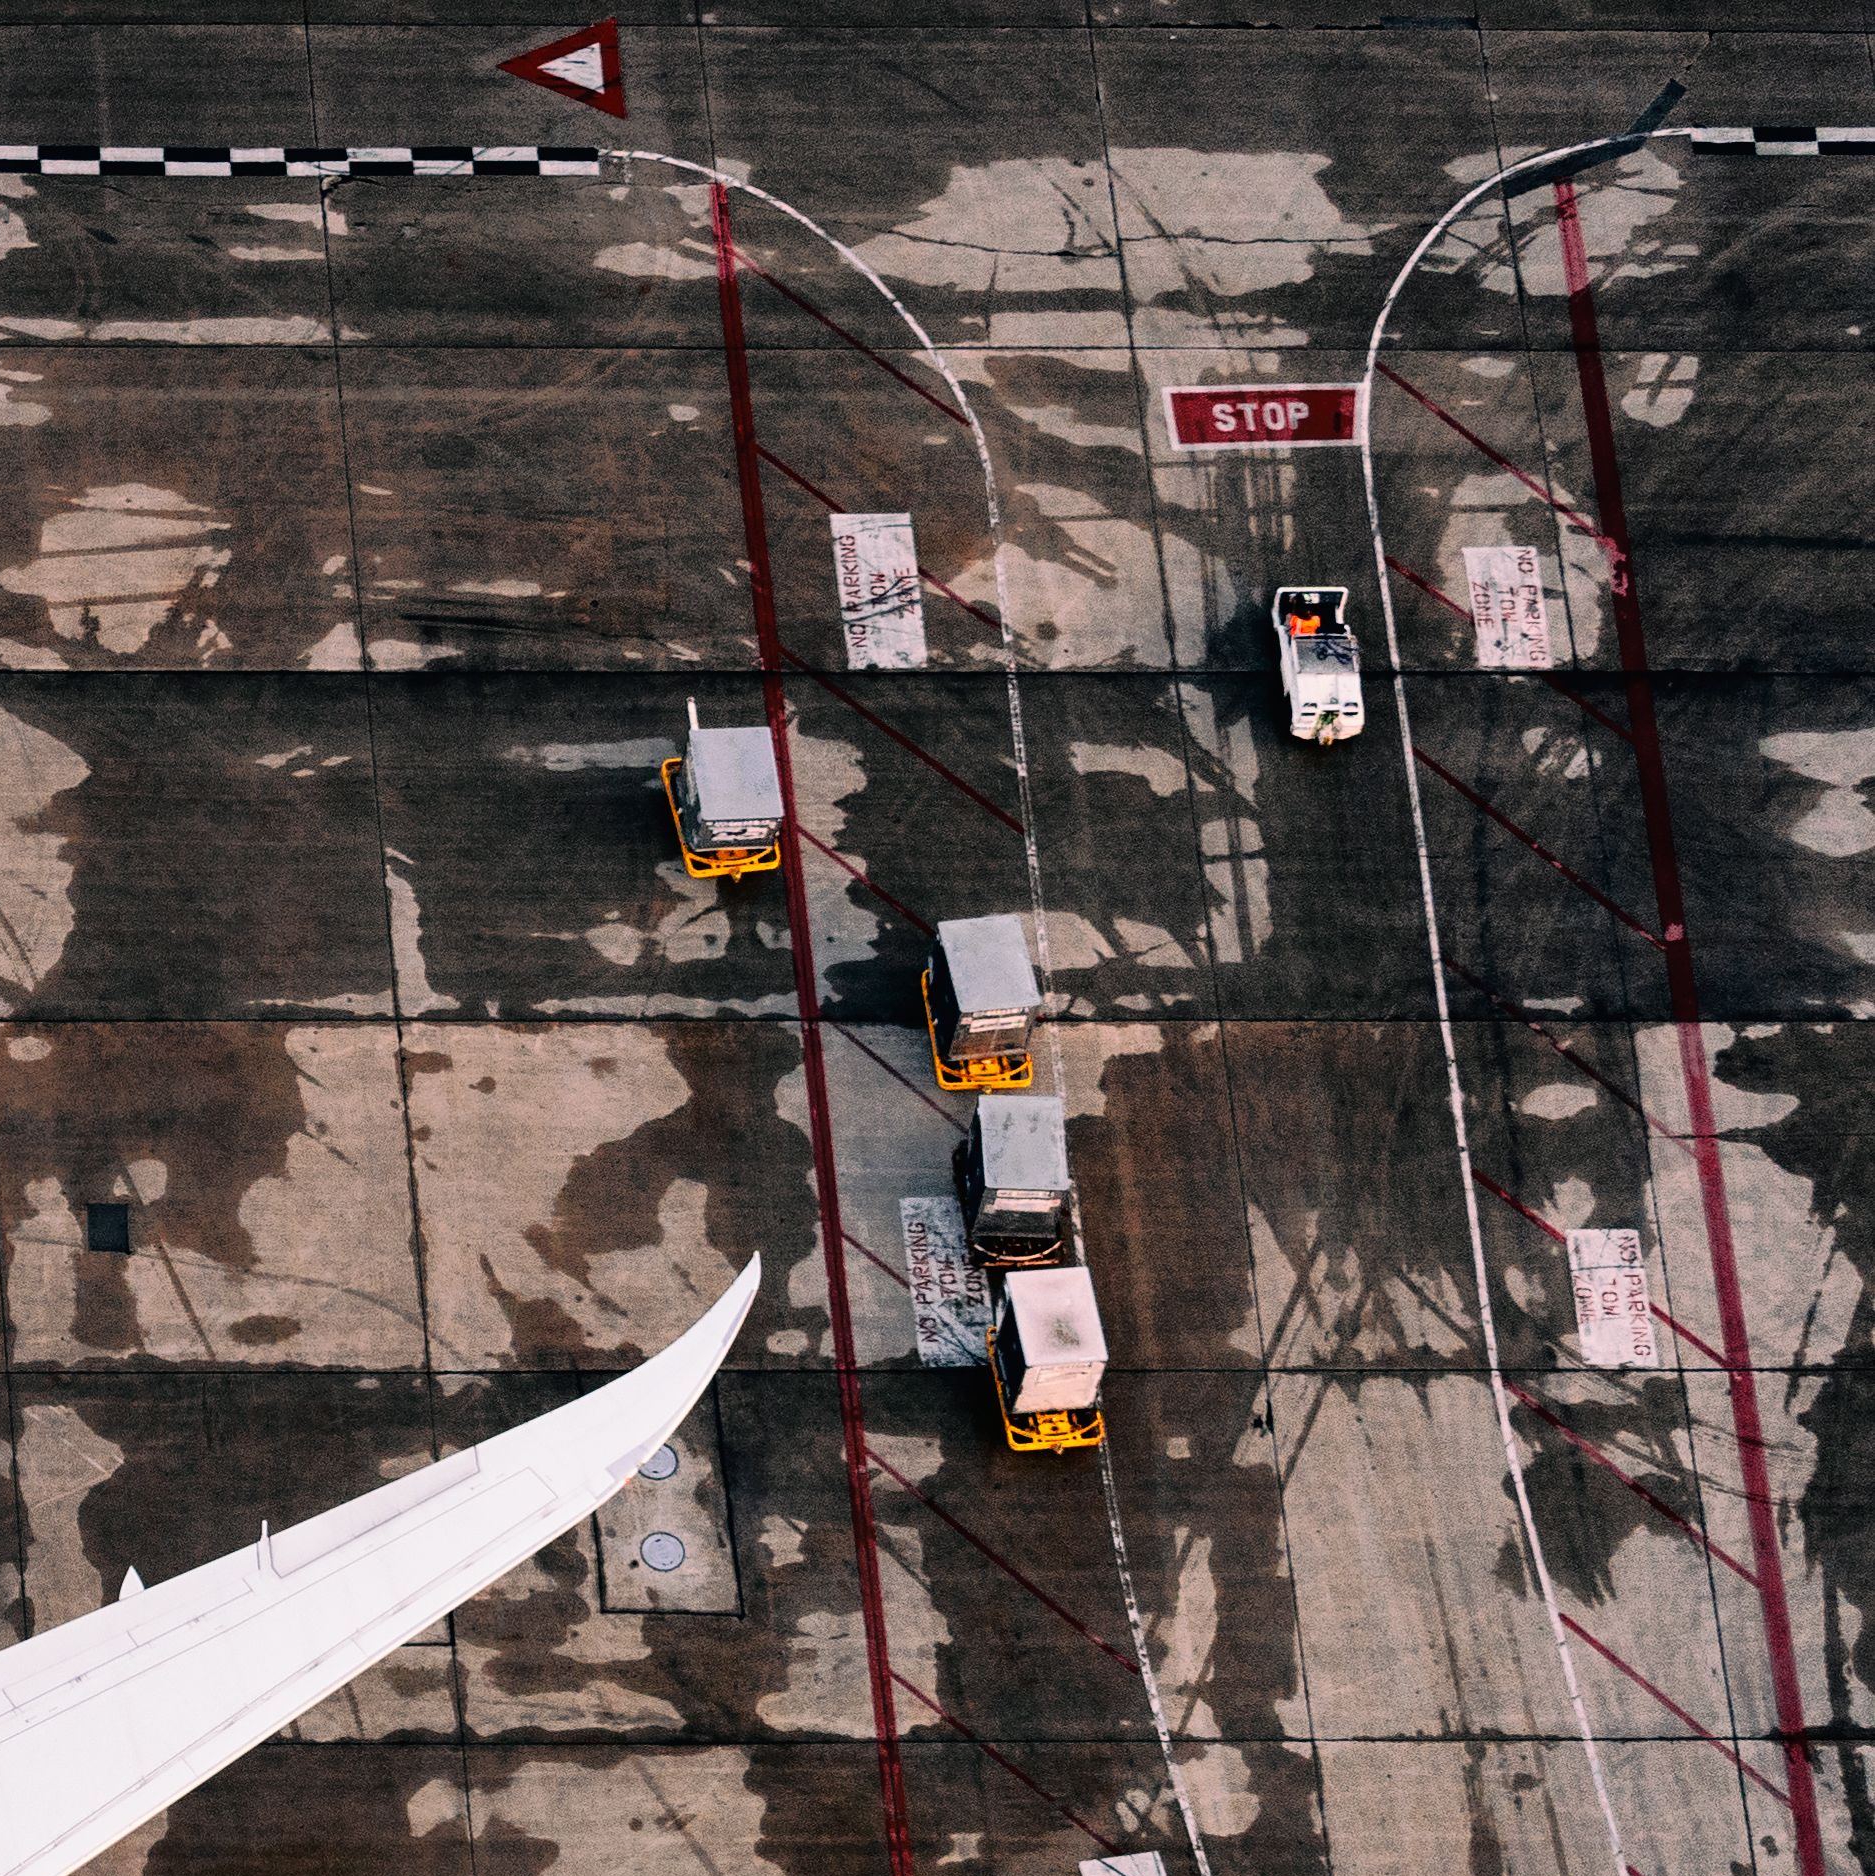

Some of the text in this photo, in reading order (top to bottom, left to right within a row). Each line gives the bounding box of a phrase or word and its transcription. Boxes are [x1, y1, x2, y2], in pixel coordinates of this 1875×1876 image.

[1212, 401, 1310, 432] STOP
[839, 535, 867, 648] NO PARKING
[870, 569, 887, 609] TOW
[1472, 581, 1495, 628] ZONE
[1497, 587, 1518, 622] TOW
[1516, 549, 1547, 661] NO PARKING
[907, 1222, 939, 1343] NO PARKING
[938, 1257, 959, 1298] TOW
[1573, 1274, 1596, 1324] ZONE
[1601, 1279, 1620, 1316] TOW
[1619, 1236, 1651, 1356] NO PARKING
